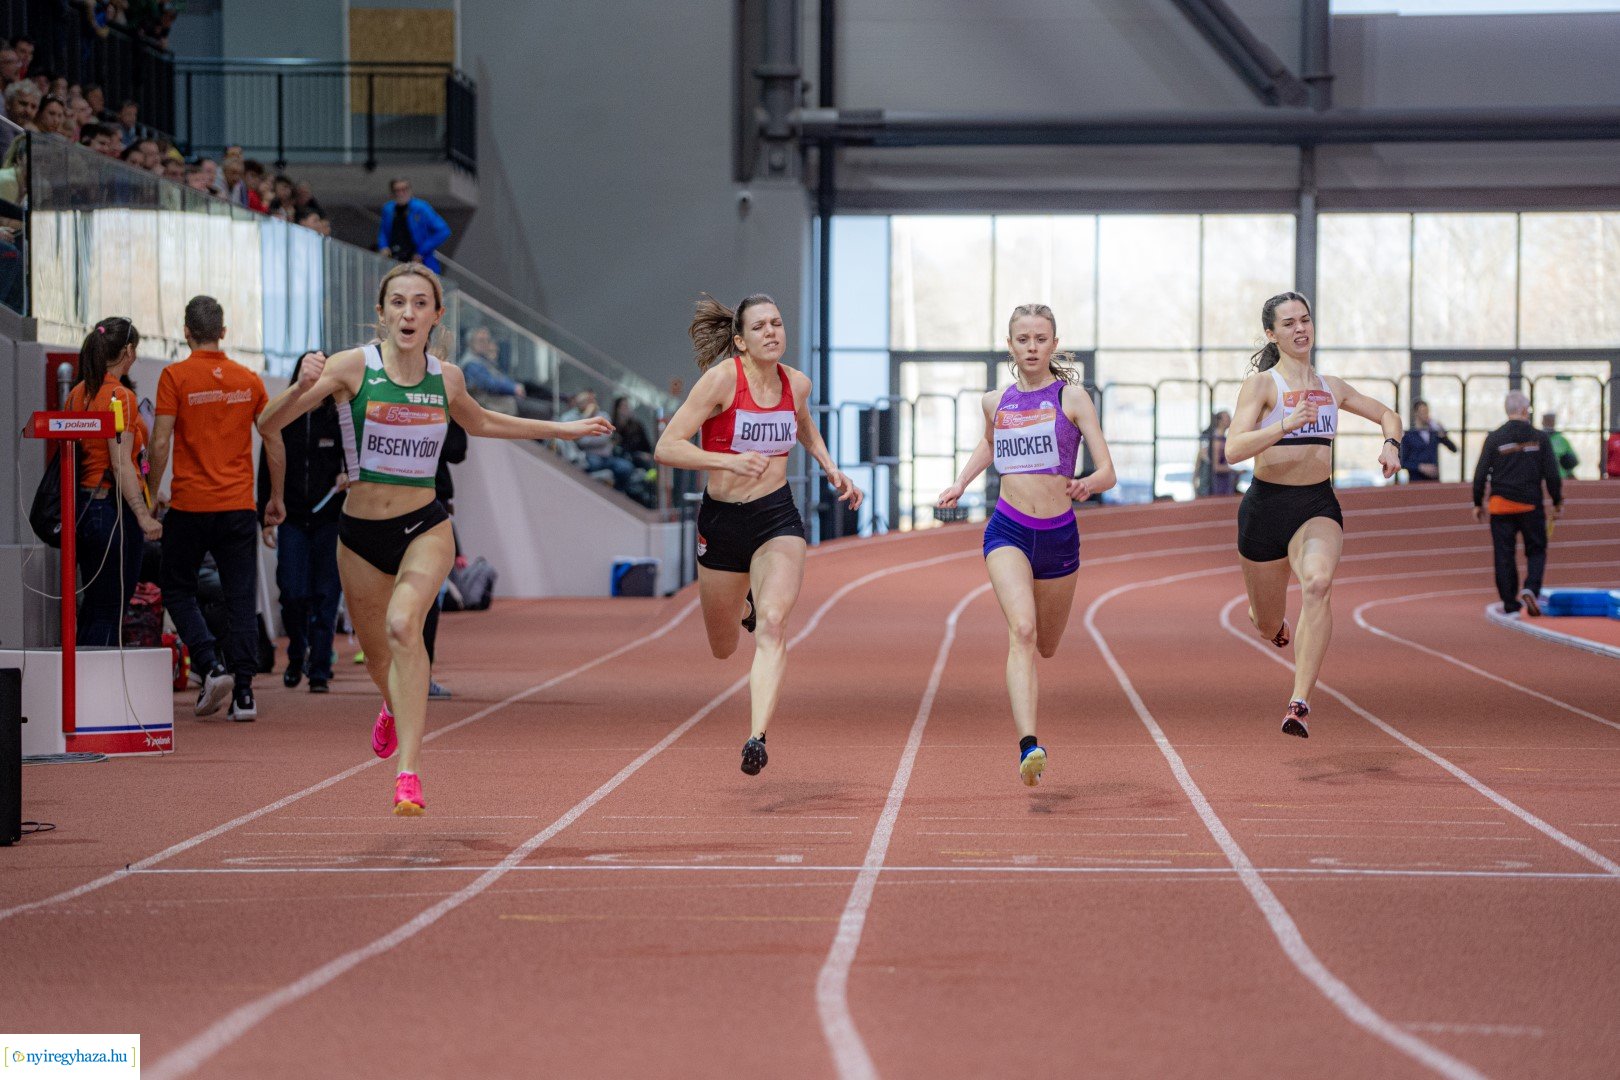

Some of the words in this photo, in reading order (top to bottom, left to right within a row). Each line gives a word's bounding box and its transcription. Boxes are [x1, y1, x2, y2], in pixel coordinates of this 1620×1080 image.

[64, 420, 98, 430] polanik
[741, 422, 792, 442] BOTLIK
[367, 434, 439, 458] BESENYŐDI
[996, 435, 1054, 458] BRUCKER
